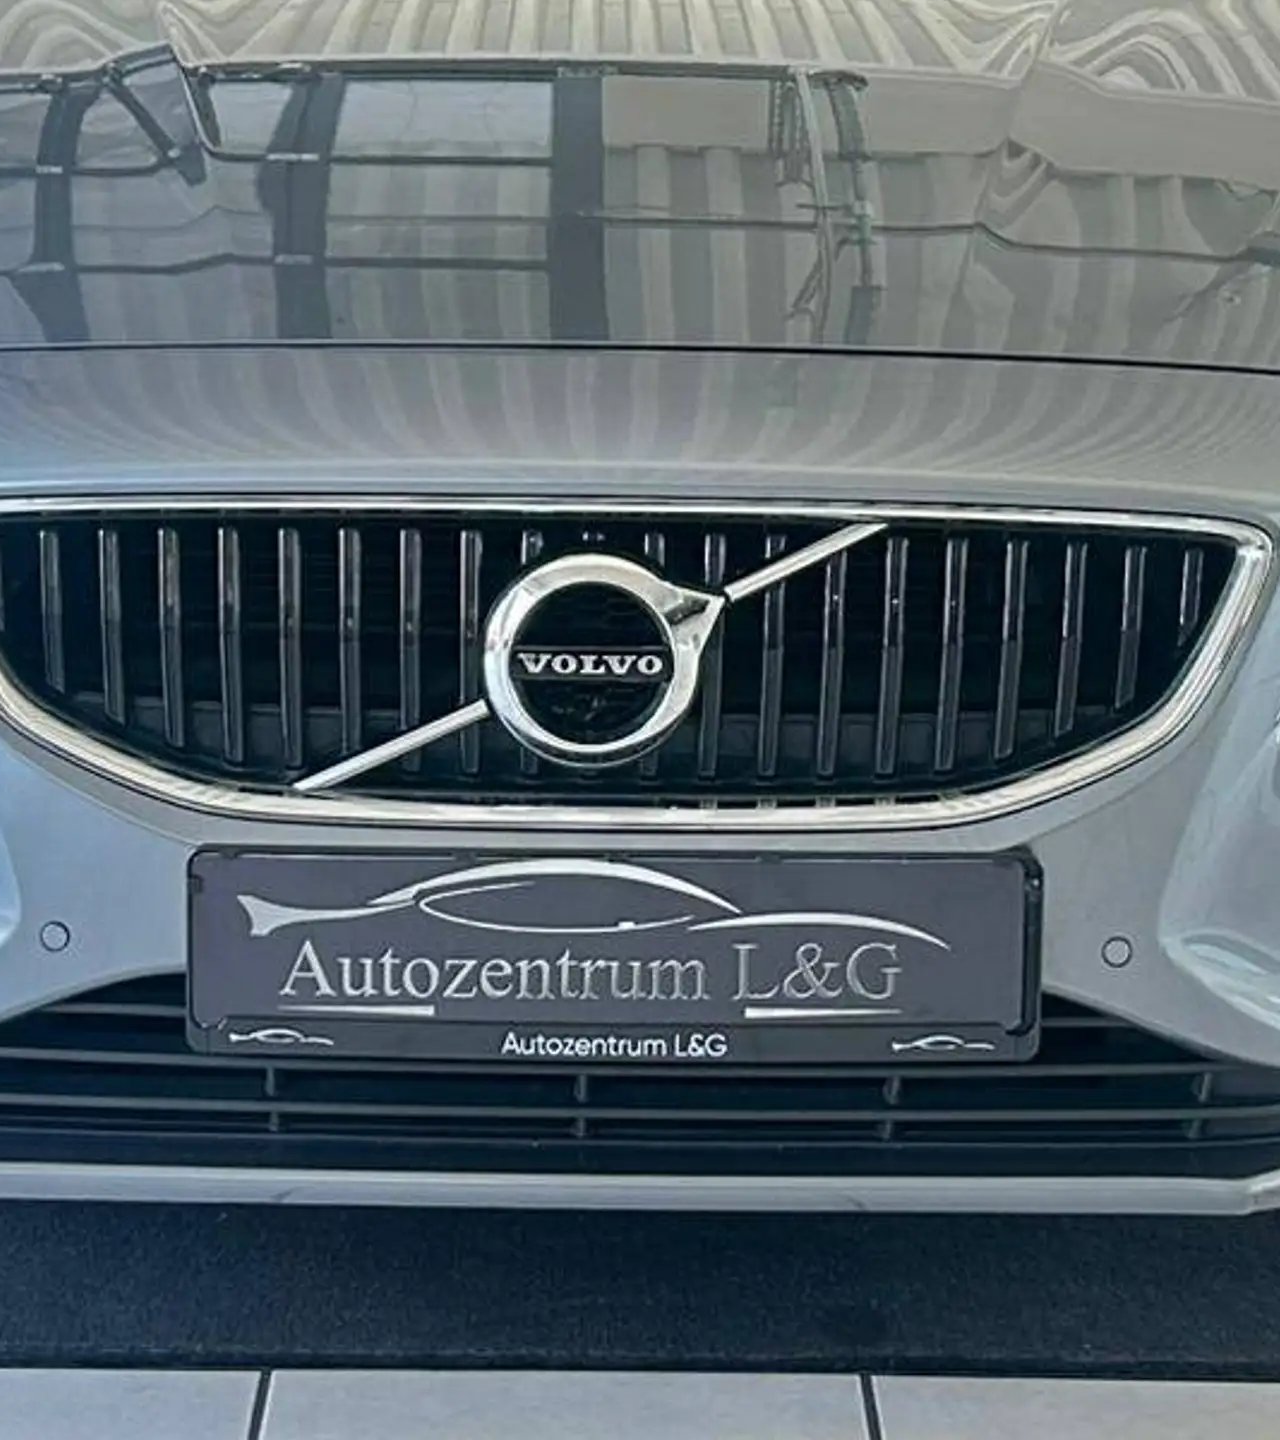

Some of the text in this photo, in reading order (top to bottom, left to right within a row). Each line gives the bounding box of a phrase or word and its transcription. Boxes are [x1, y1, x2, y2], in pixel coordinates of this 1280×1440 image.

[518, 652, 663, 675] VOLVO
[282, 940, 904, 1003] Autozentrum L&G
[502, 1032, 728, 1059] Autozentrum L&G
